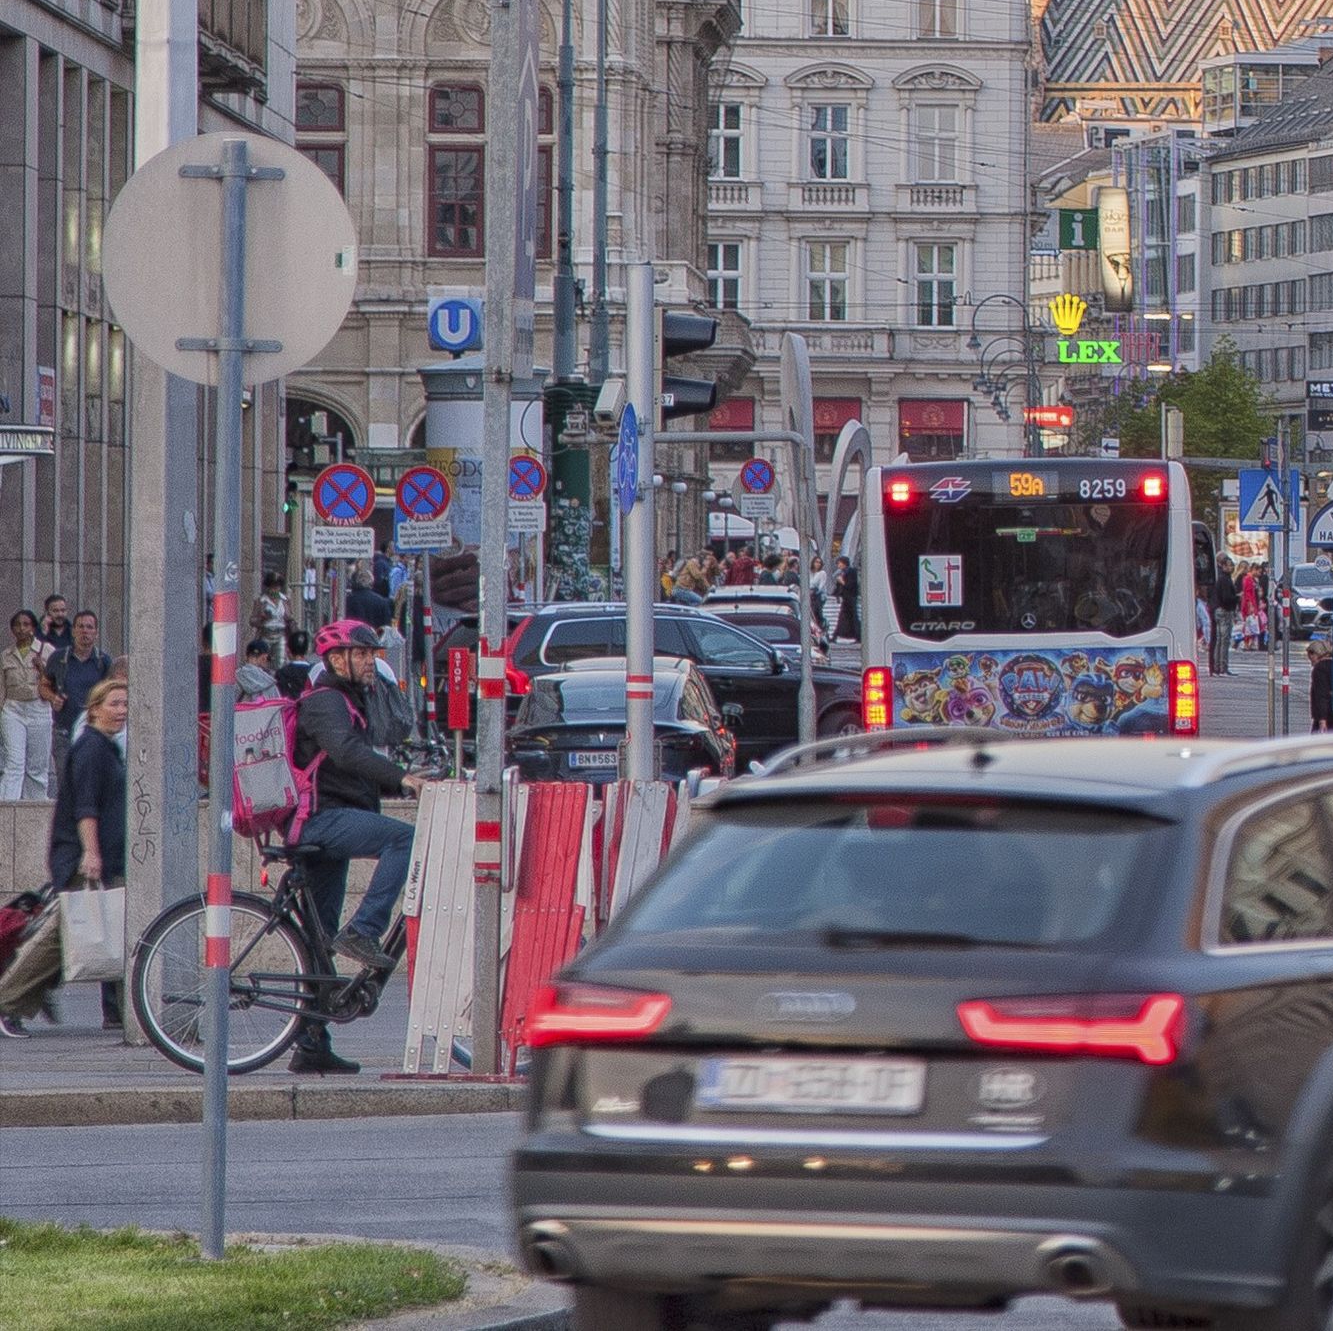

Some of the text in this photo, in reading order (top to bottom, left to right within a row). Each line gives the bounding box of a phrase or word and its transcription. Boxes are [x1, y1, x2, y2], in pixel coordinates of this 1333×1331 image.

[438, 309, 471, 344] U
[1009, 473, 1044, 496] 59A
[1080, 479, 1126, 498] 8259
[910, 621, 975, 632] CITARO
[235, 726, 280, 746] foodora
